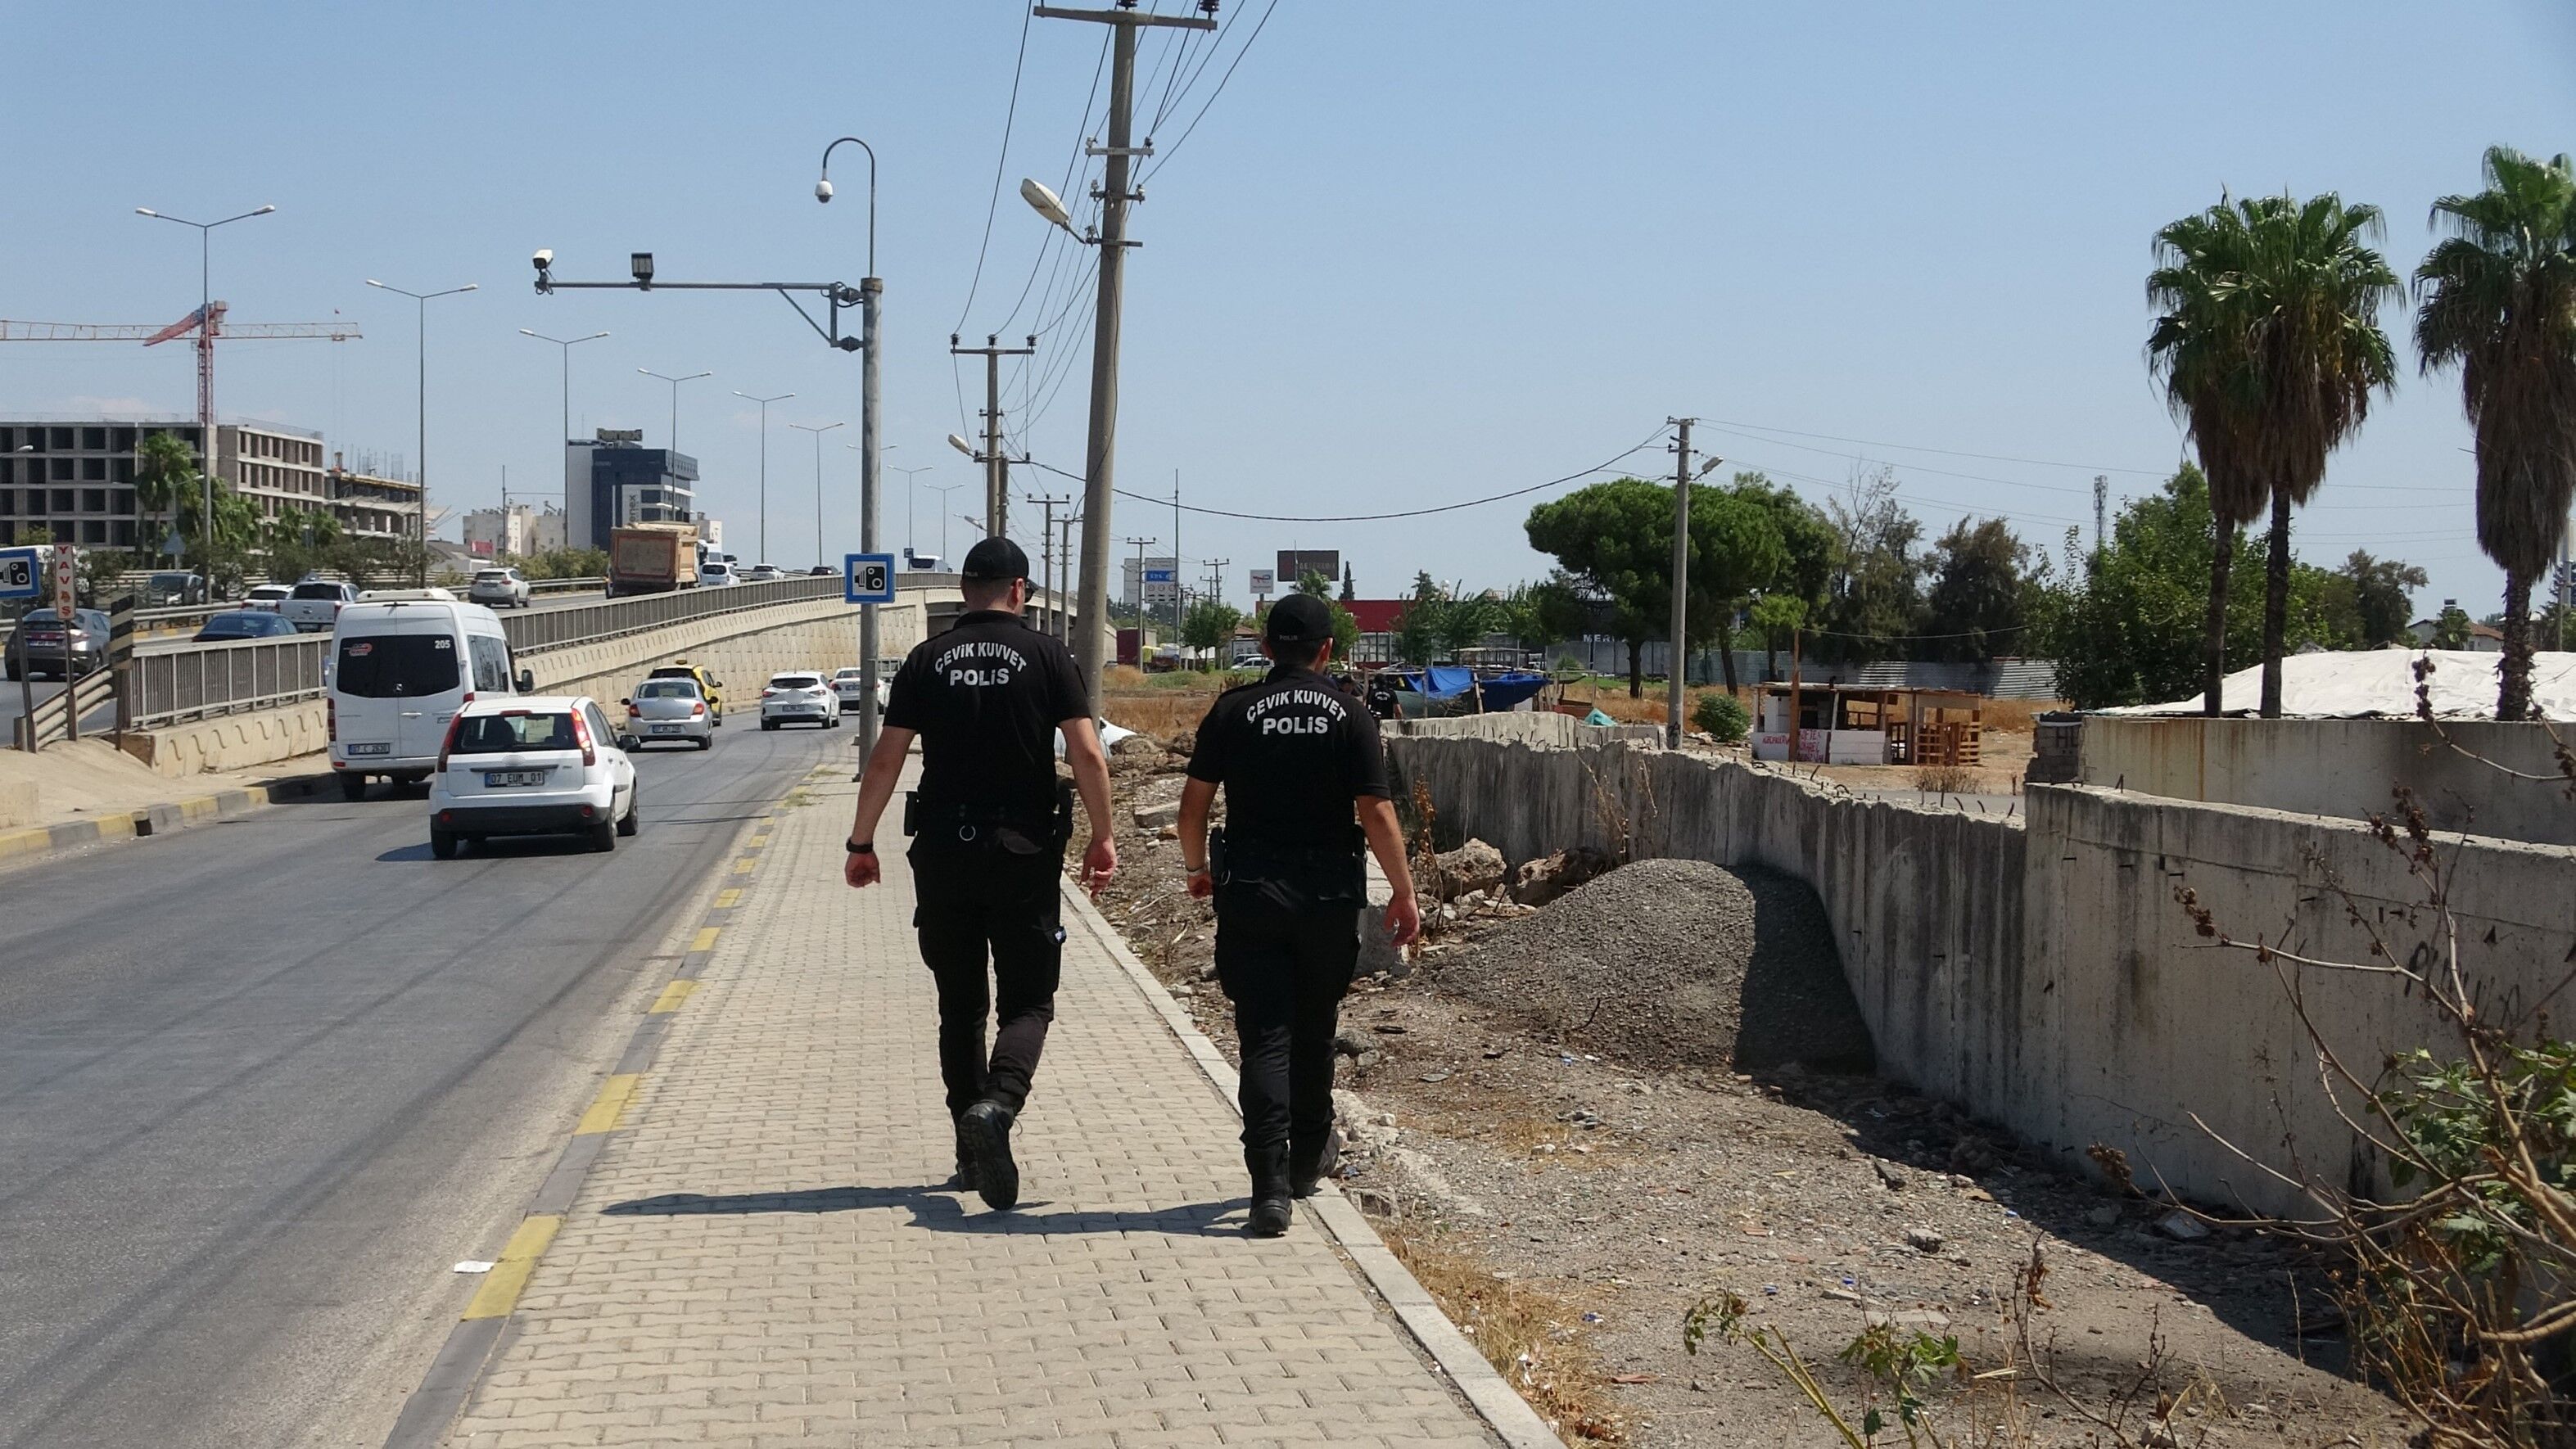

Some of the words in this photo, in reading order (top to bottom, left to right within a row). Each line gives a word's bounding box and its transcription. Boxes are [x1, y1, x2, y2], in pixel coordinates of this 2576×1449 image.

[58, 546, 71, 616] YAVAŞ
[435, 639, 450, 649] 205
[935, 643, 974, 675] ÇEVİK
[978, 642, 1027, 672] KUVVET
[950, 668, 1010, 686] POLİS
[1246, 691, 1290, 724] ÇEVİK
[1294, 689, 1347, 722] KUVVET
[1263, 716, 1328, 735] POLİS
[491, 774, 502, 783] 07
[531, 773, 542, 783] 01
